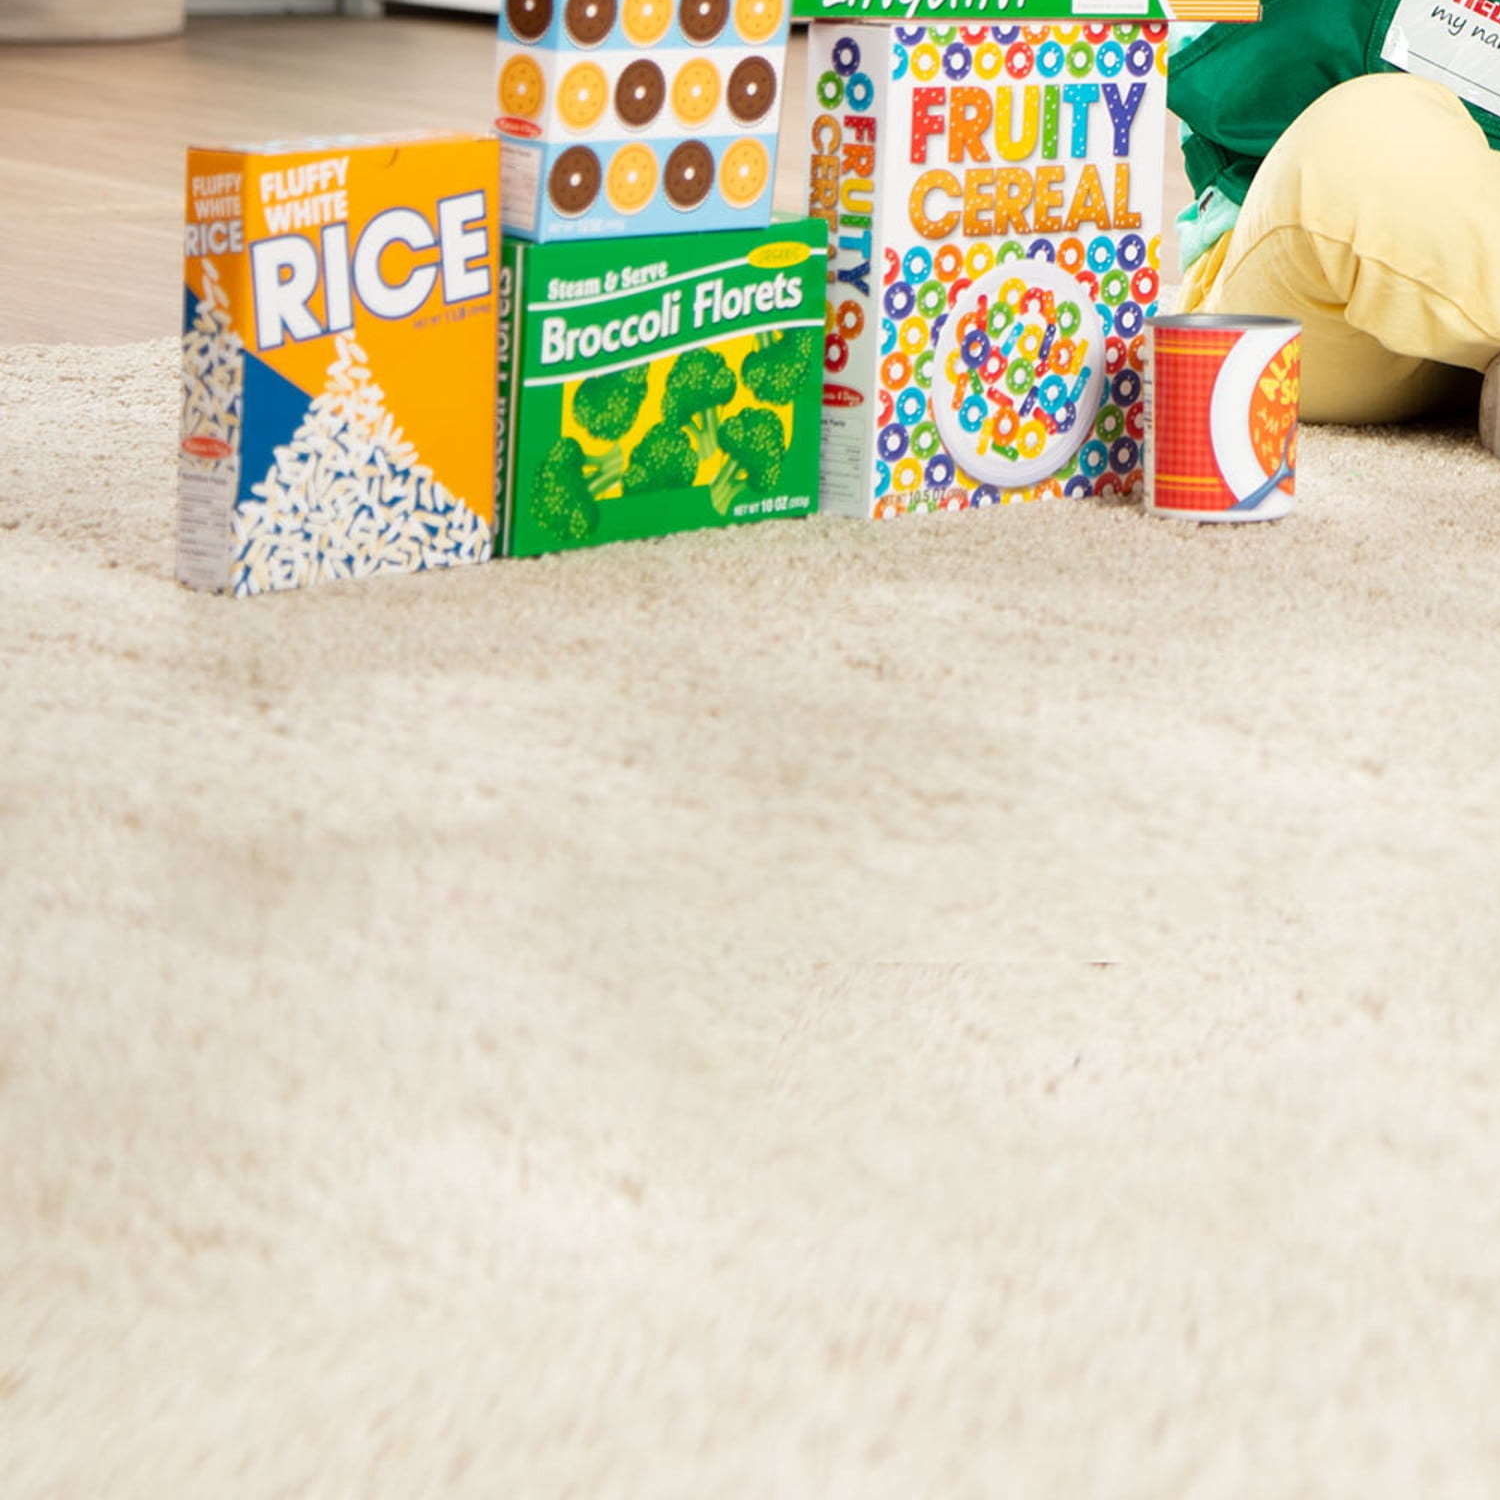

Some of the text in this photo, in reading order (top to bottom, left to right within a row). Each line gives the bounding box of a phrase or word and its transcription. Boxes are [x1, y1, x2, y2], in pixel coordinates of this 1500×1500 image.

[1431, 4, 1467, 37] my
[910, 83, 1147, 164] FRUITY
[191, 172, 243, 198] FLUFFY
[260, 156, 349, 203] FLUFFY
[908, 163, 1142, 240] CEREAL
[194, 195, 241, 220] WHITE
[264, 190, 349, 233] WHITE
[837, 115, 877, 297] FRUITY
[185, 220, 243, 258] RICE
[250, 189, 492, 352] RICE
[548, 261, 668, 300] Steam & Serve
[540, 272, 803, 365] Broccoli Florets
